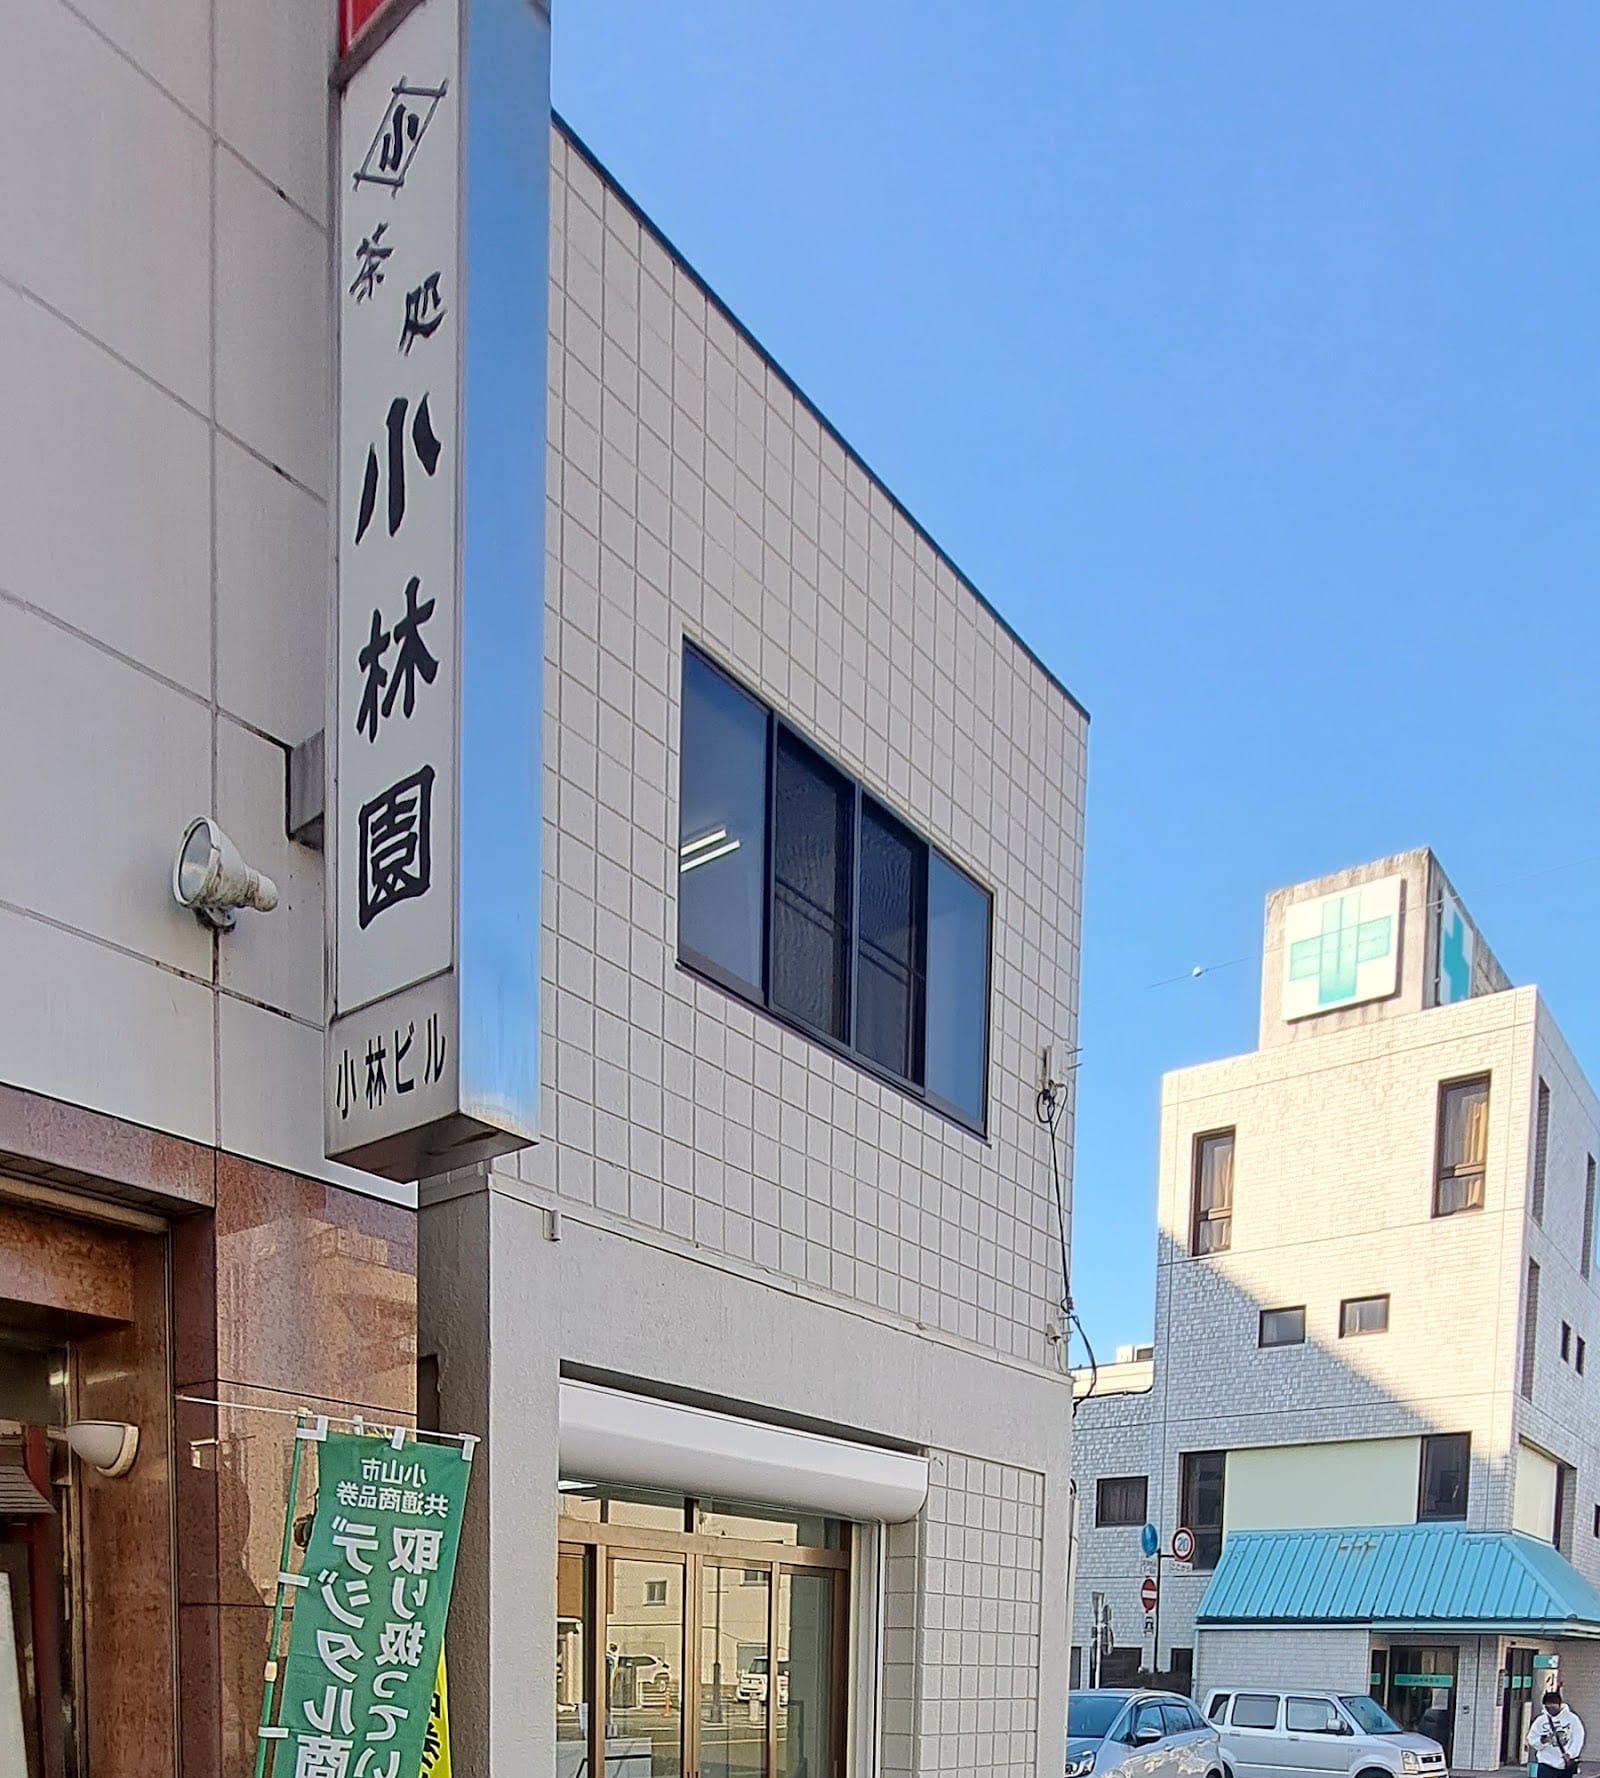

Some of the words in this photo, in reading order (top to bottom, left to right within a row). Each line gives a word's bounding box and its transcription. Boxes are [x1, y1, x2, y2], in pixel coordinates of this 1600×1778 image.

[355, 392, 440, 930] 小林園
[335, 1012, 446, 1120] 小林ビル
[1177, 1536, 1189, 1552] 20
